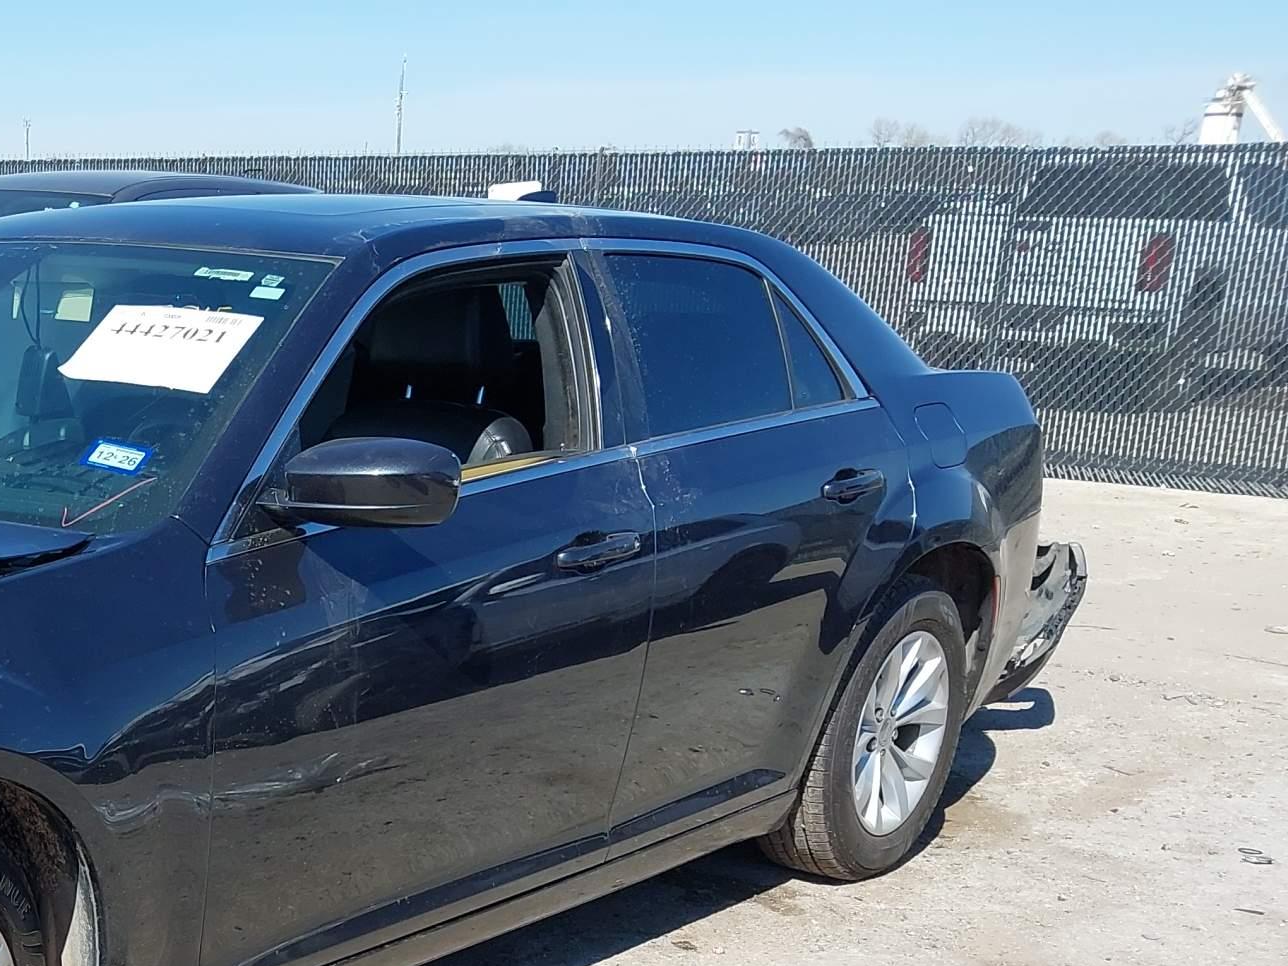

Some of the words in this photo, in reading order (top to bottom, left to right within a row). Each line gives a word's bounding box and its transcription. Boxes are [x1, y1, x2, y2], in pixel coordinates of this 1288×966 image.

[111, 321, 228, 344] 44427021
[96, 450, 115, 462] 12
[117, 455, 139, 467] 26
